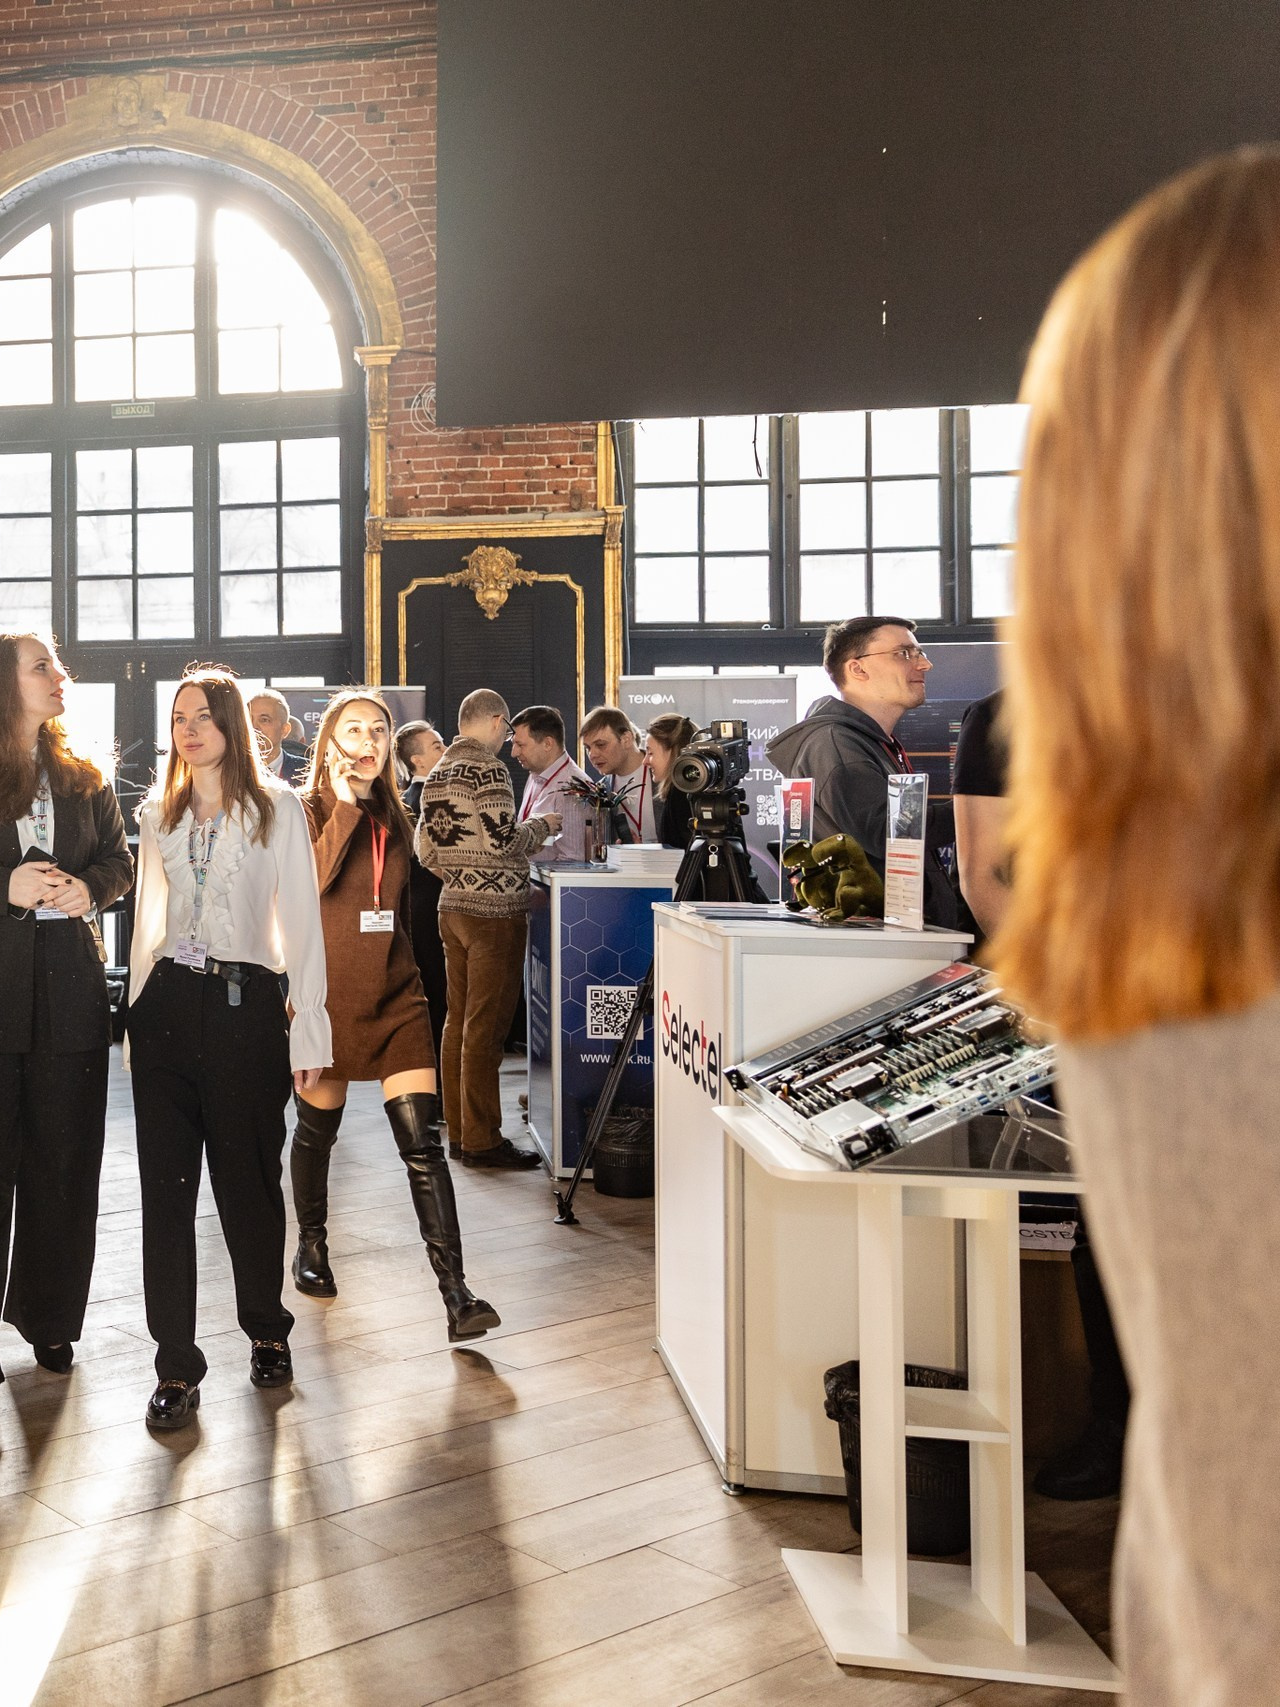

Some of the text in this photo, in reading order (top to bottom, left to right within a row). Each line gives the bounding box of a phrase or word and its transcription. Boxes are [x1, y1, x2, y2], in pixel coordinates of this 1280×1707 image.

[115, 405, 151, 415] ВЫХОД
[747, 725, 779, 740] КИЙ
[740, 768, 784, 782] СТВА
[662, 990, 722, 1105] Selectel
